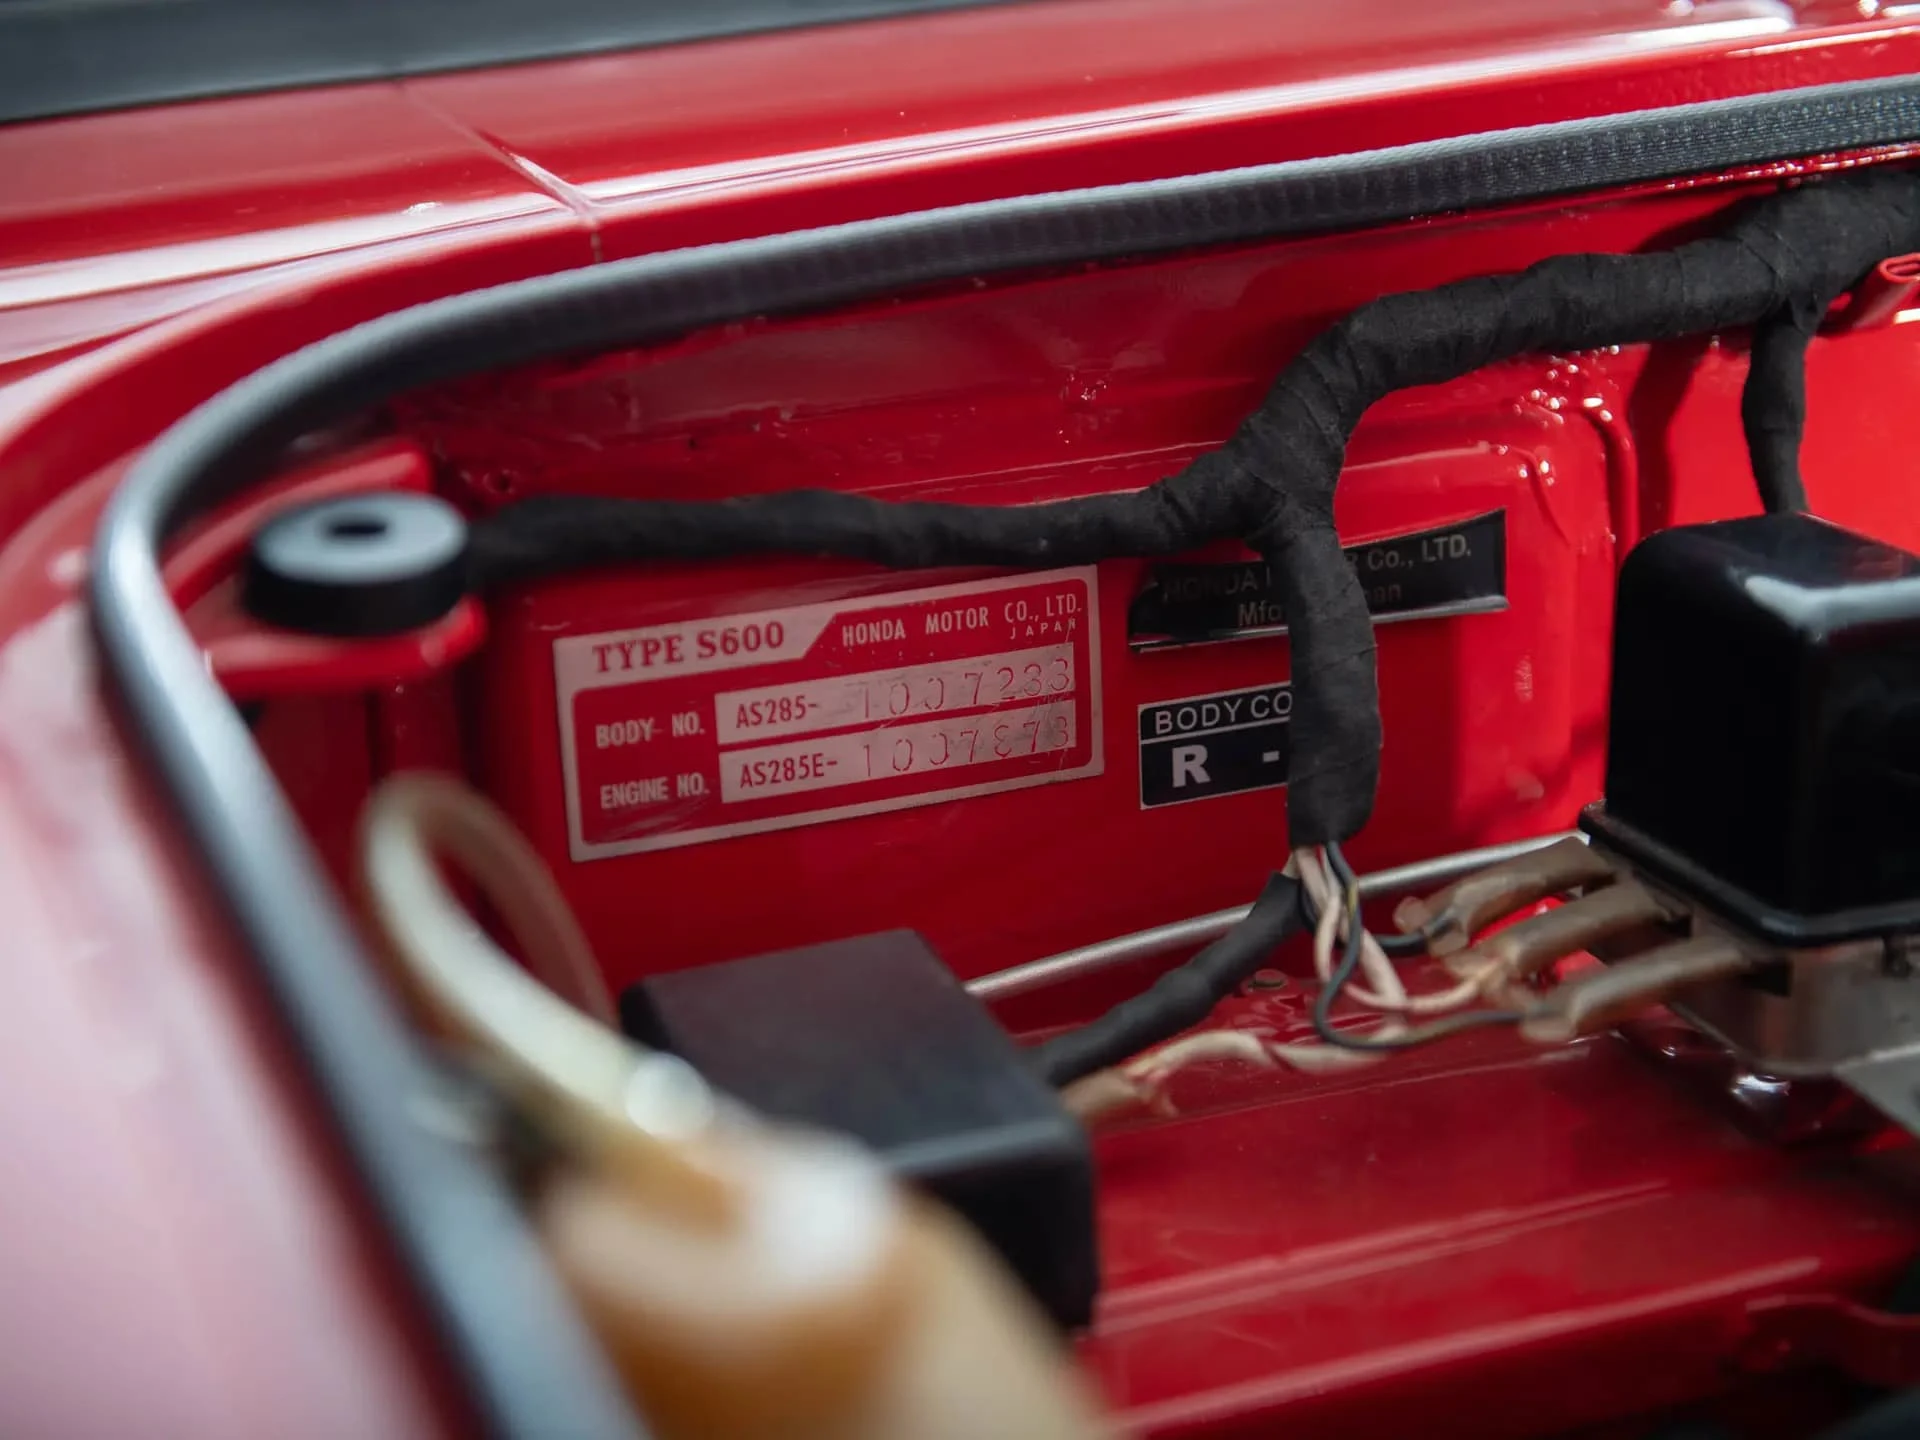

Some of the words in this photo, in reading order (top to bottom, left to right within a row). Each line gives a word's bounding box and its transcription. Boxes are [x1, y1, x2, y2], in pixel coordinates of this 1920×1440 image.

[1421, 534, 1472, 563] LTD.
[592, 633, 684, 673] TYPE
[696, 622, 785, 659] S600
[842, 618, 906, 647] HONDA
[925, 606, 989, 635] MOTOR
[1010, 619, 1077, 640] JAPAN
[595, 717, 655, 749] BODY
[671, 711, 706, 737] NO.
[735, 697, 818, 729] AS285-
[1155, 698, 1242, 735] BODY
[1250, 690, 1292, 718] CO
[600, 776, 669, 809] ENGINE
[676, 772, 710, 798] NO.
[740, 753, 838, 788] AS285E-
[1172, 744, 1211, 788] R
